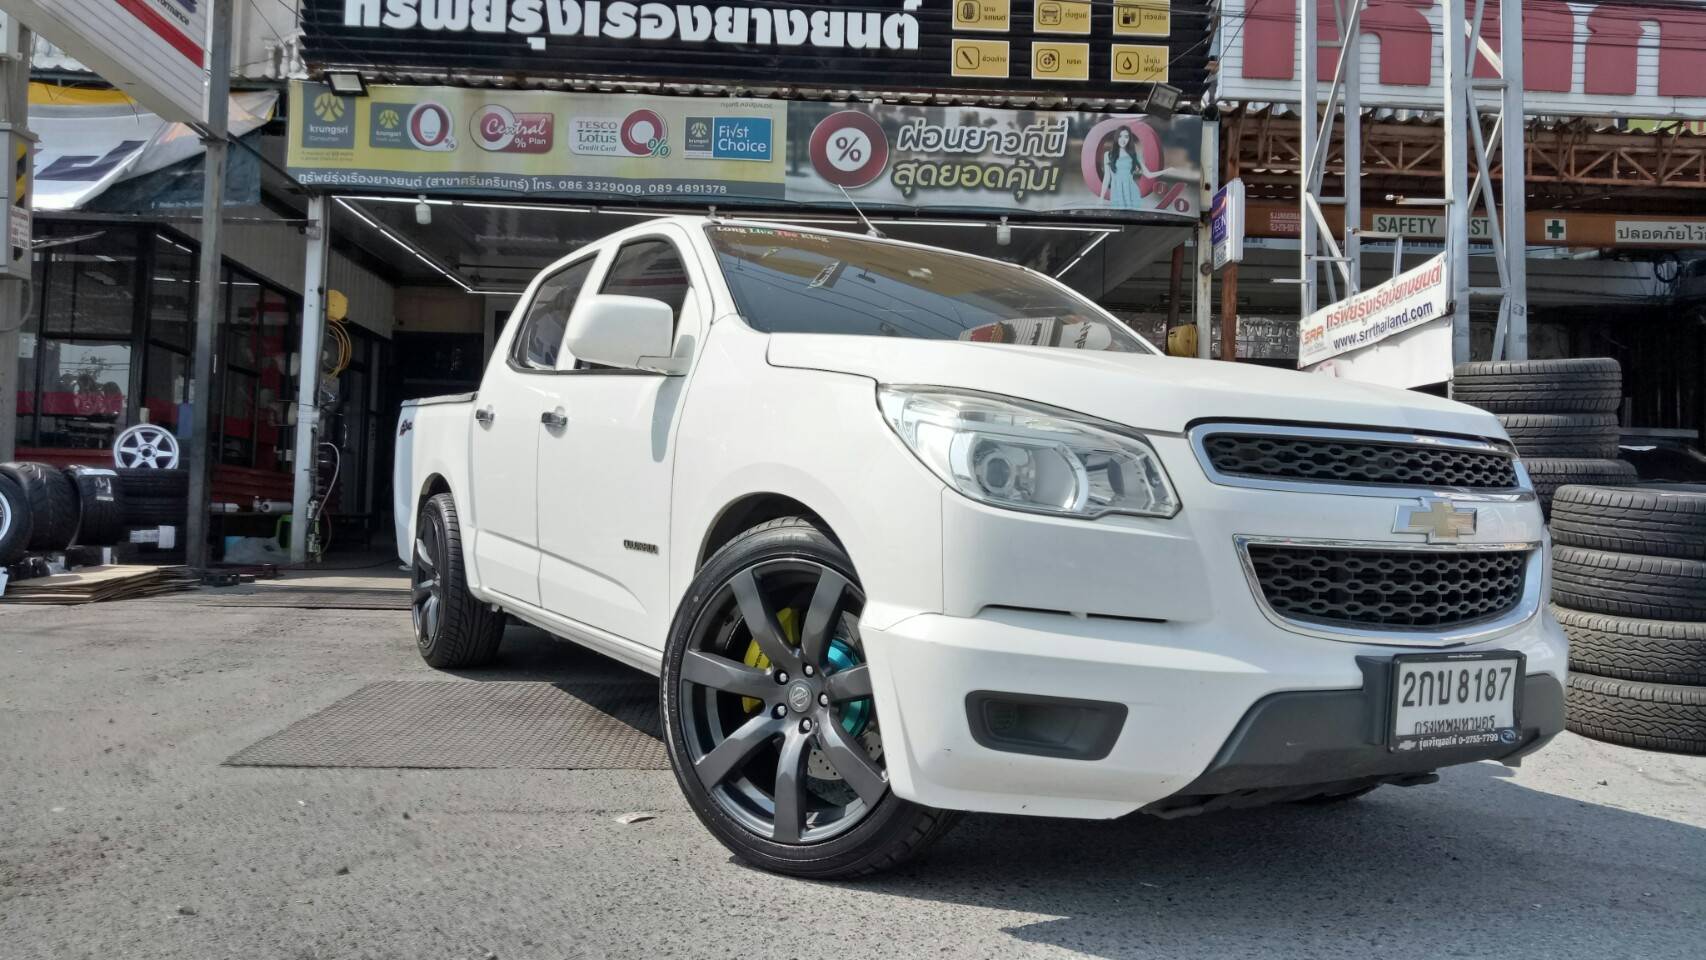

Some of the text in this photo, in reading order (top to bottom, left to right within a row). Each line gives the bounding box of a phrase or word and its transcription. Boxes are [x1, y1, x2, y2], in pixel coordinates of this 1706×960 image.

[310, 124, 349, 136] krungsri
[486, 117, 546, 137] Central
[578, 120, 617, 130] TESCO
[719, 123, 749, 138] First
[528, 137, 547, 146] Plan
[578, 132, 617, 144] Lotus
[718, 138, 767, 153] Choice
[897, 118, 1068, 158] ผ่อนยาวที่นี่
[578, 144, 617, 152] Credit Card
[532, 177, 554, 191] โทร.
[558, 180, 582, 190] 086
[587, 180, 645, 195] 3329008,
[648, 183, 672, 193] 089
[676, 183, 727, 194] 4891378
[893, 162, 1058, 196] สุดยอดคุ้ม!
[1377, 216, 1437, 235] SAFETY
[1617, 224, 1706, 240] ปลอดภัยไว้
[1333, 301, 1433, 350] www.srrthailand.com
[1401, 666, 1512, 708] 2กบ 8187
